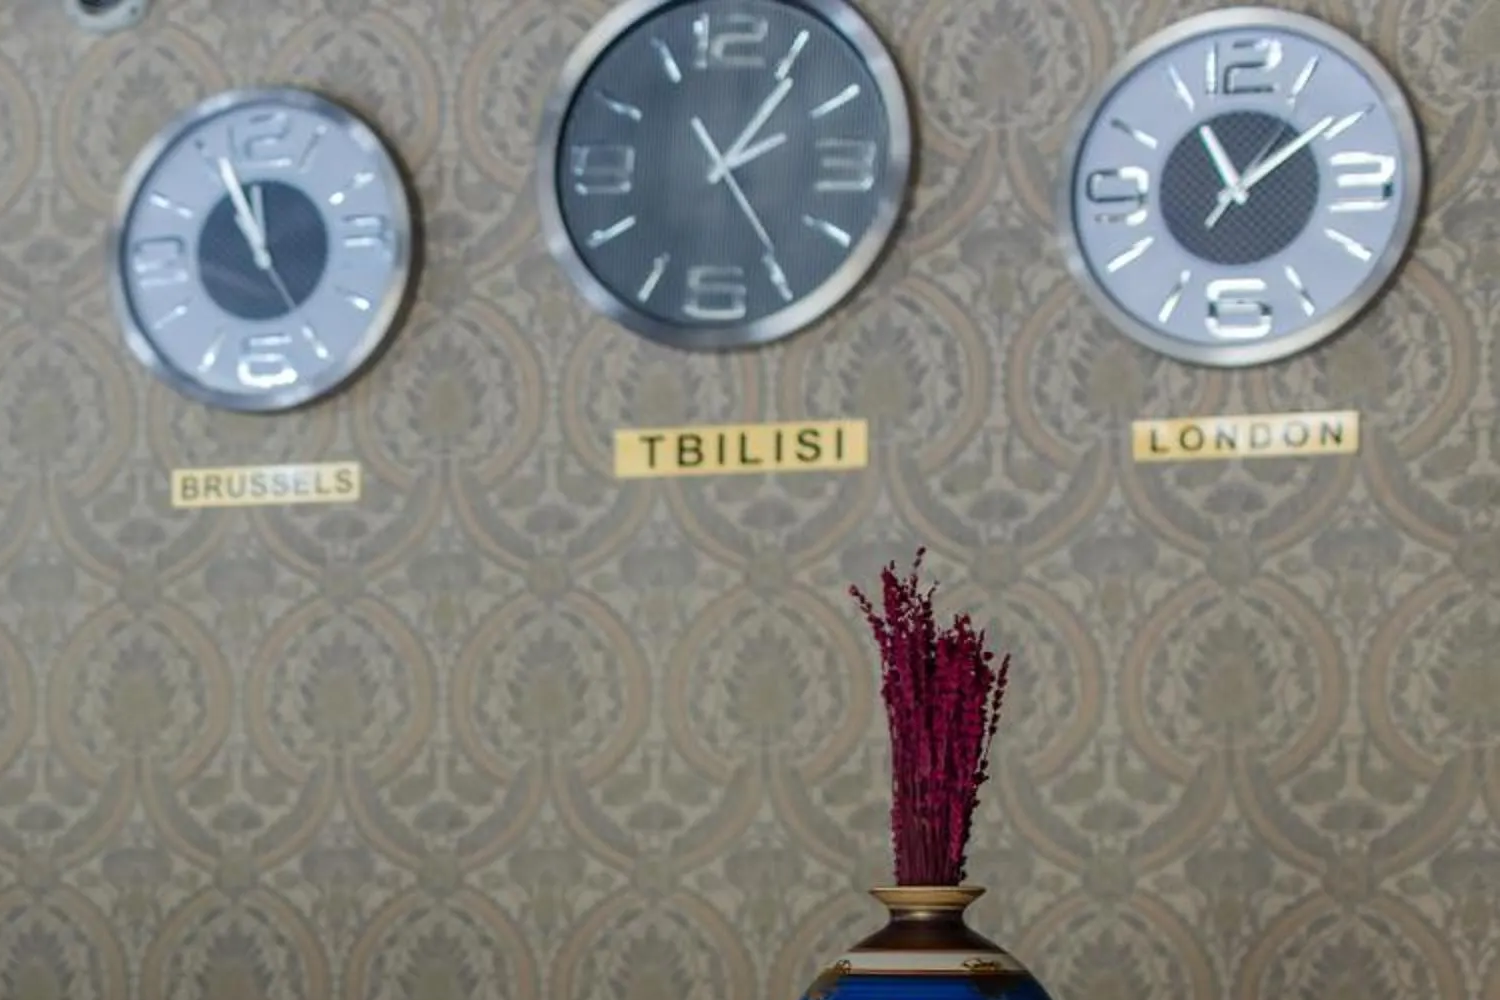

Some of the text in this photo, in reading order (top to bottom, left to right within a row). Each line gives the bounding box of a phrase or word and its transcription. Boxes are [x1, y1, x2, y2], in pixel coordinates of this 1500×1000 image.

[694, 13, 768, 69] 12
[1206, 39, 1282, 97] 12
[814, 138, 877, 191] 3
[1329, 151, 1396, 213] 3
[1086, 166, 1149, 226] 9
[1205, 278, 1272, 338] 6
[639, 427, 845, 470] TBILISI
[1150, 421, 1344, 454] LONDON
[180, 468, 355, 500] BRUSSELS
